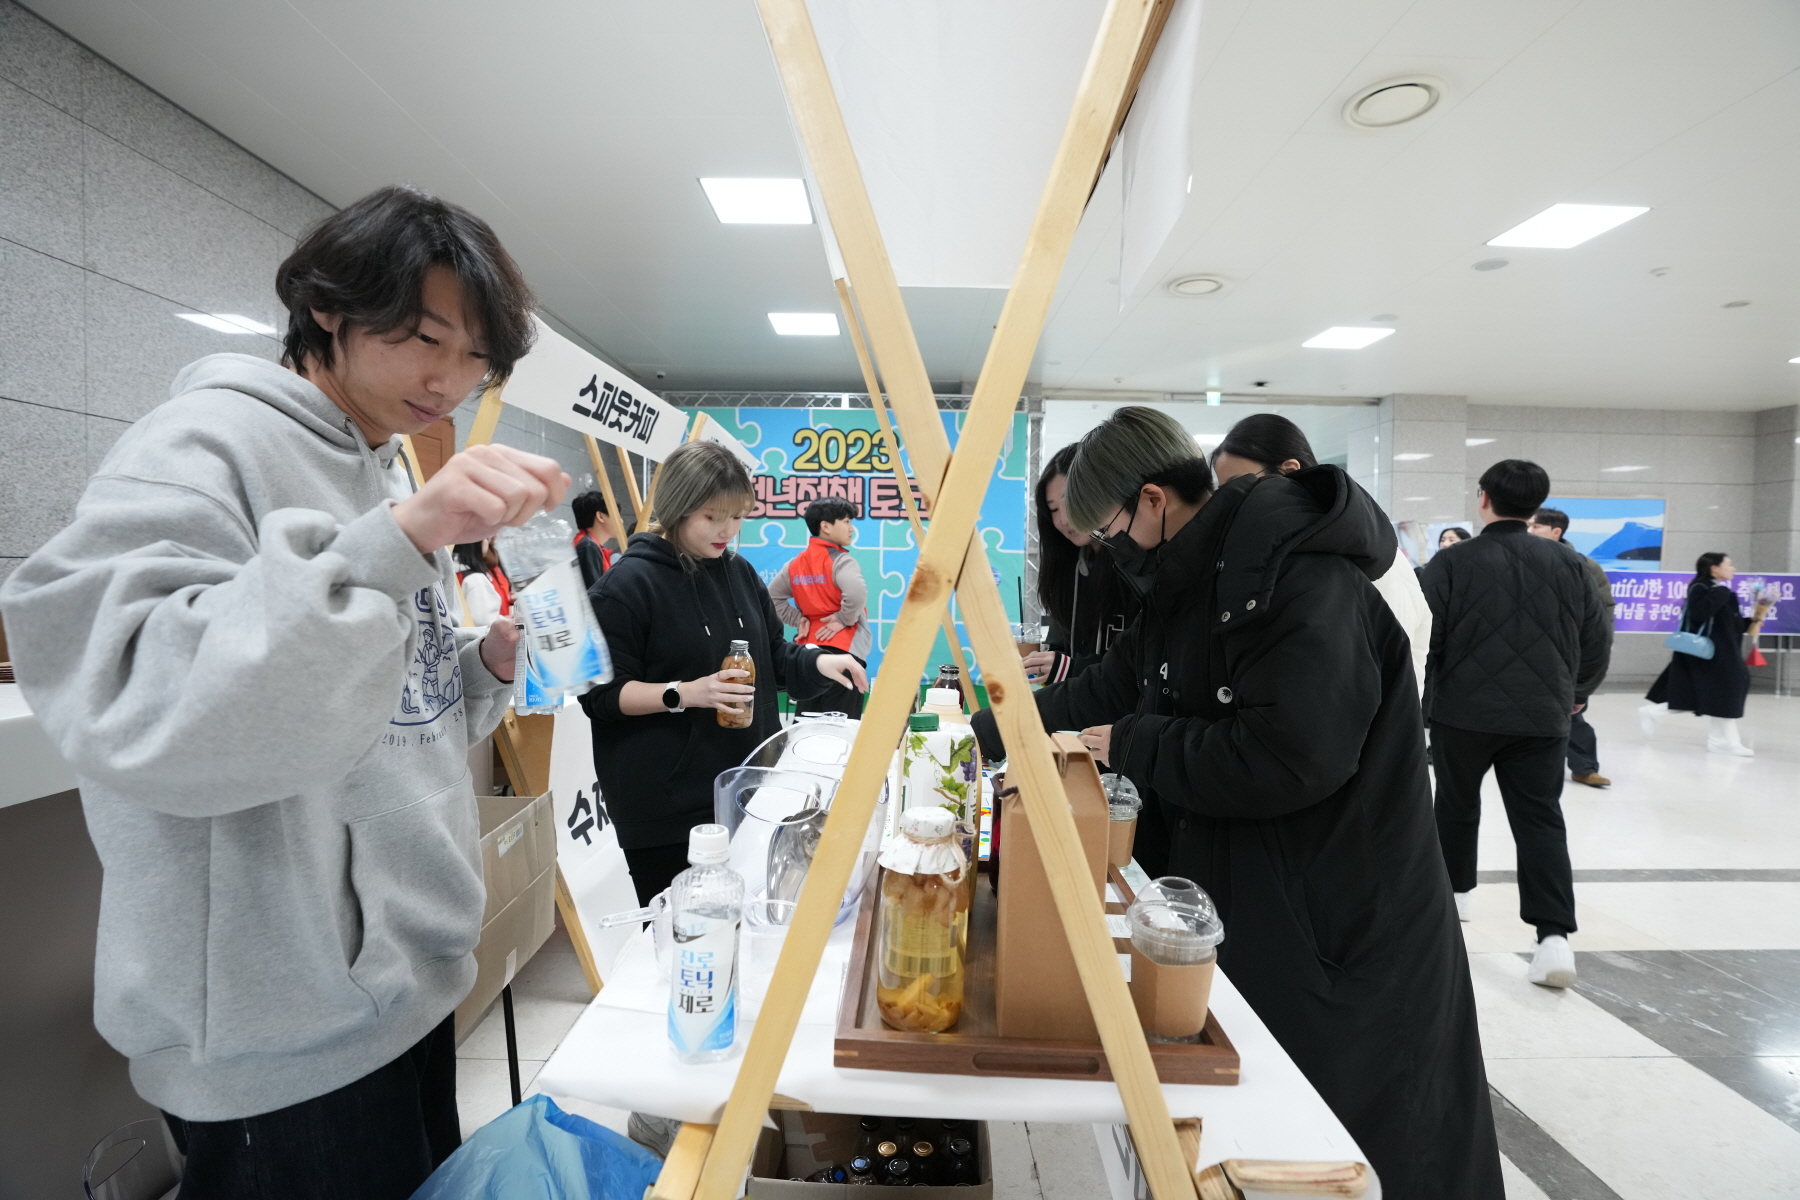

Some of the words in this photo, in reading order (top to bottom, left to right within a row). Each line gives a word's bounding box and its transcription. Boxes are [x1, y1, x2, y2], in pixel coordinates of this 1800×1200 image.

[792, 428, 899, 471] 2023
[680, 949, 715, 969] 진로
[680, 969, 713, 989] 토닉
[678, 992, 715, 1014] 제로
